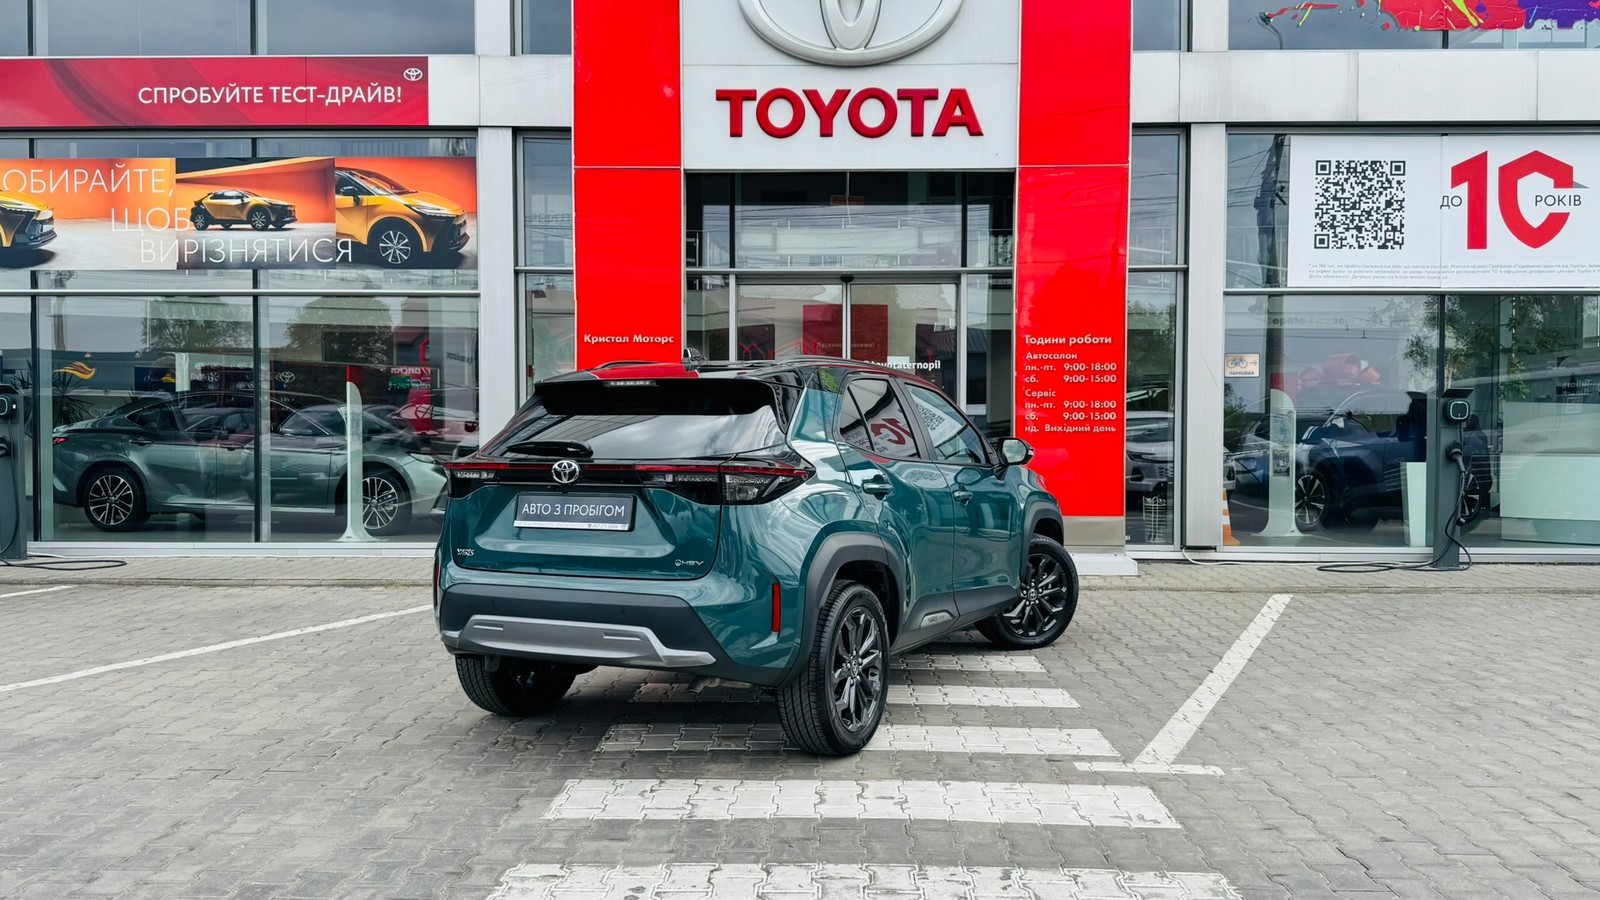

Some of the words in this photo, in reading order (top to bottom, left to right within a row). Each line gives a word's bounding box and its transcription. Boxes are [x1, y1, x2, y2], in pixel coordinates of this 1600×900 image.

[138, 83, 264, 104] СПРОБУЙТЕ
[270, 82, 402, 106] ТЕСТ-ДРАЙВ!
[715, 87, 984, 138] TOYOTA
[2, 163, 174, 197] ОБИРАЙТЕ,
[1439, 195, 1463, 210] ДО
[1534, 194, 1582, 207] РОКІВ
[111, 207, 190, 235] ЩОБ
[140, 238, 352, 263] ВИРІЗНЯТИСЯ
[583, 334, 629, 345] Кристал
[632, 334, 674, 345] Моторс
[1025, 334, 1066, 345] Години
[1069, 334, 1112, 346] роботи
[1025, 351, 1078, 360] Автосалон
[1025, 374, 1039, 383] сб.
[1025, 388, 1056, 399] Сервіс
[1025, 401, 1056, 409] пн.-пт.
[1025, 411, 1039, 420] сб.
[1044, 423, 1091, 432] Вихідний
[522, 503, 552, 515] АВТО
[553, 504, 561, 515] З
[563, 504, 625, 517] ПРОБІГОМ
